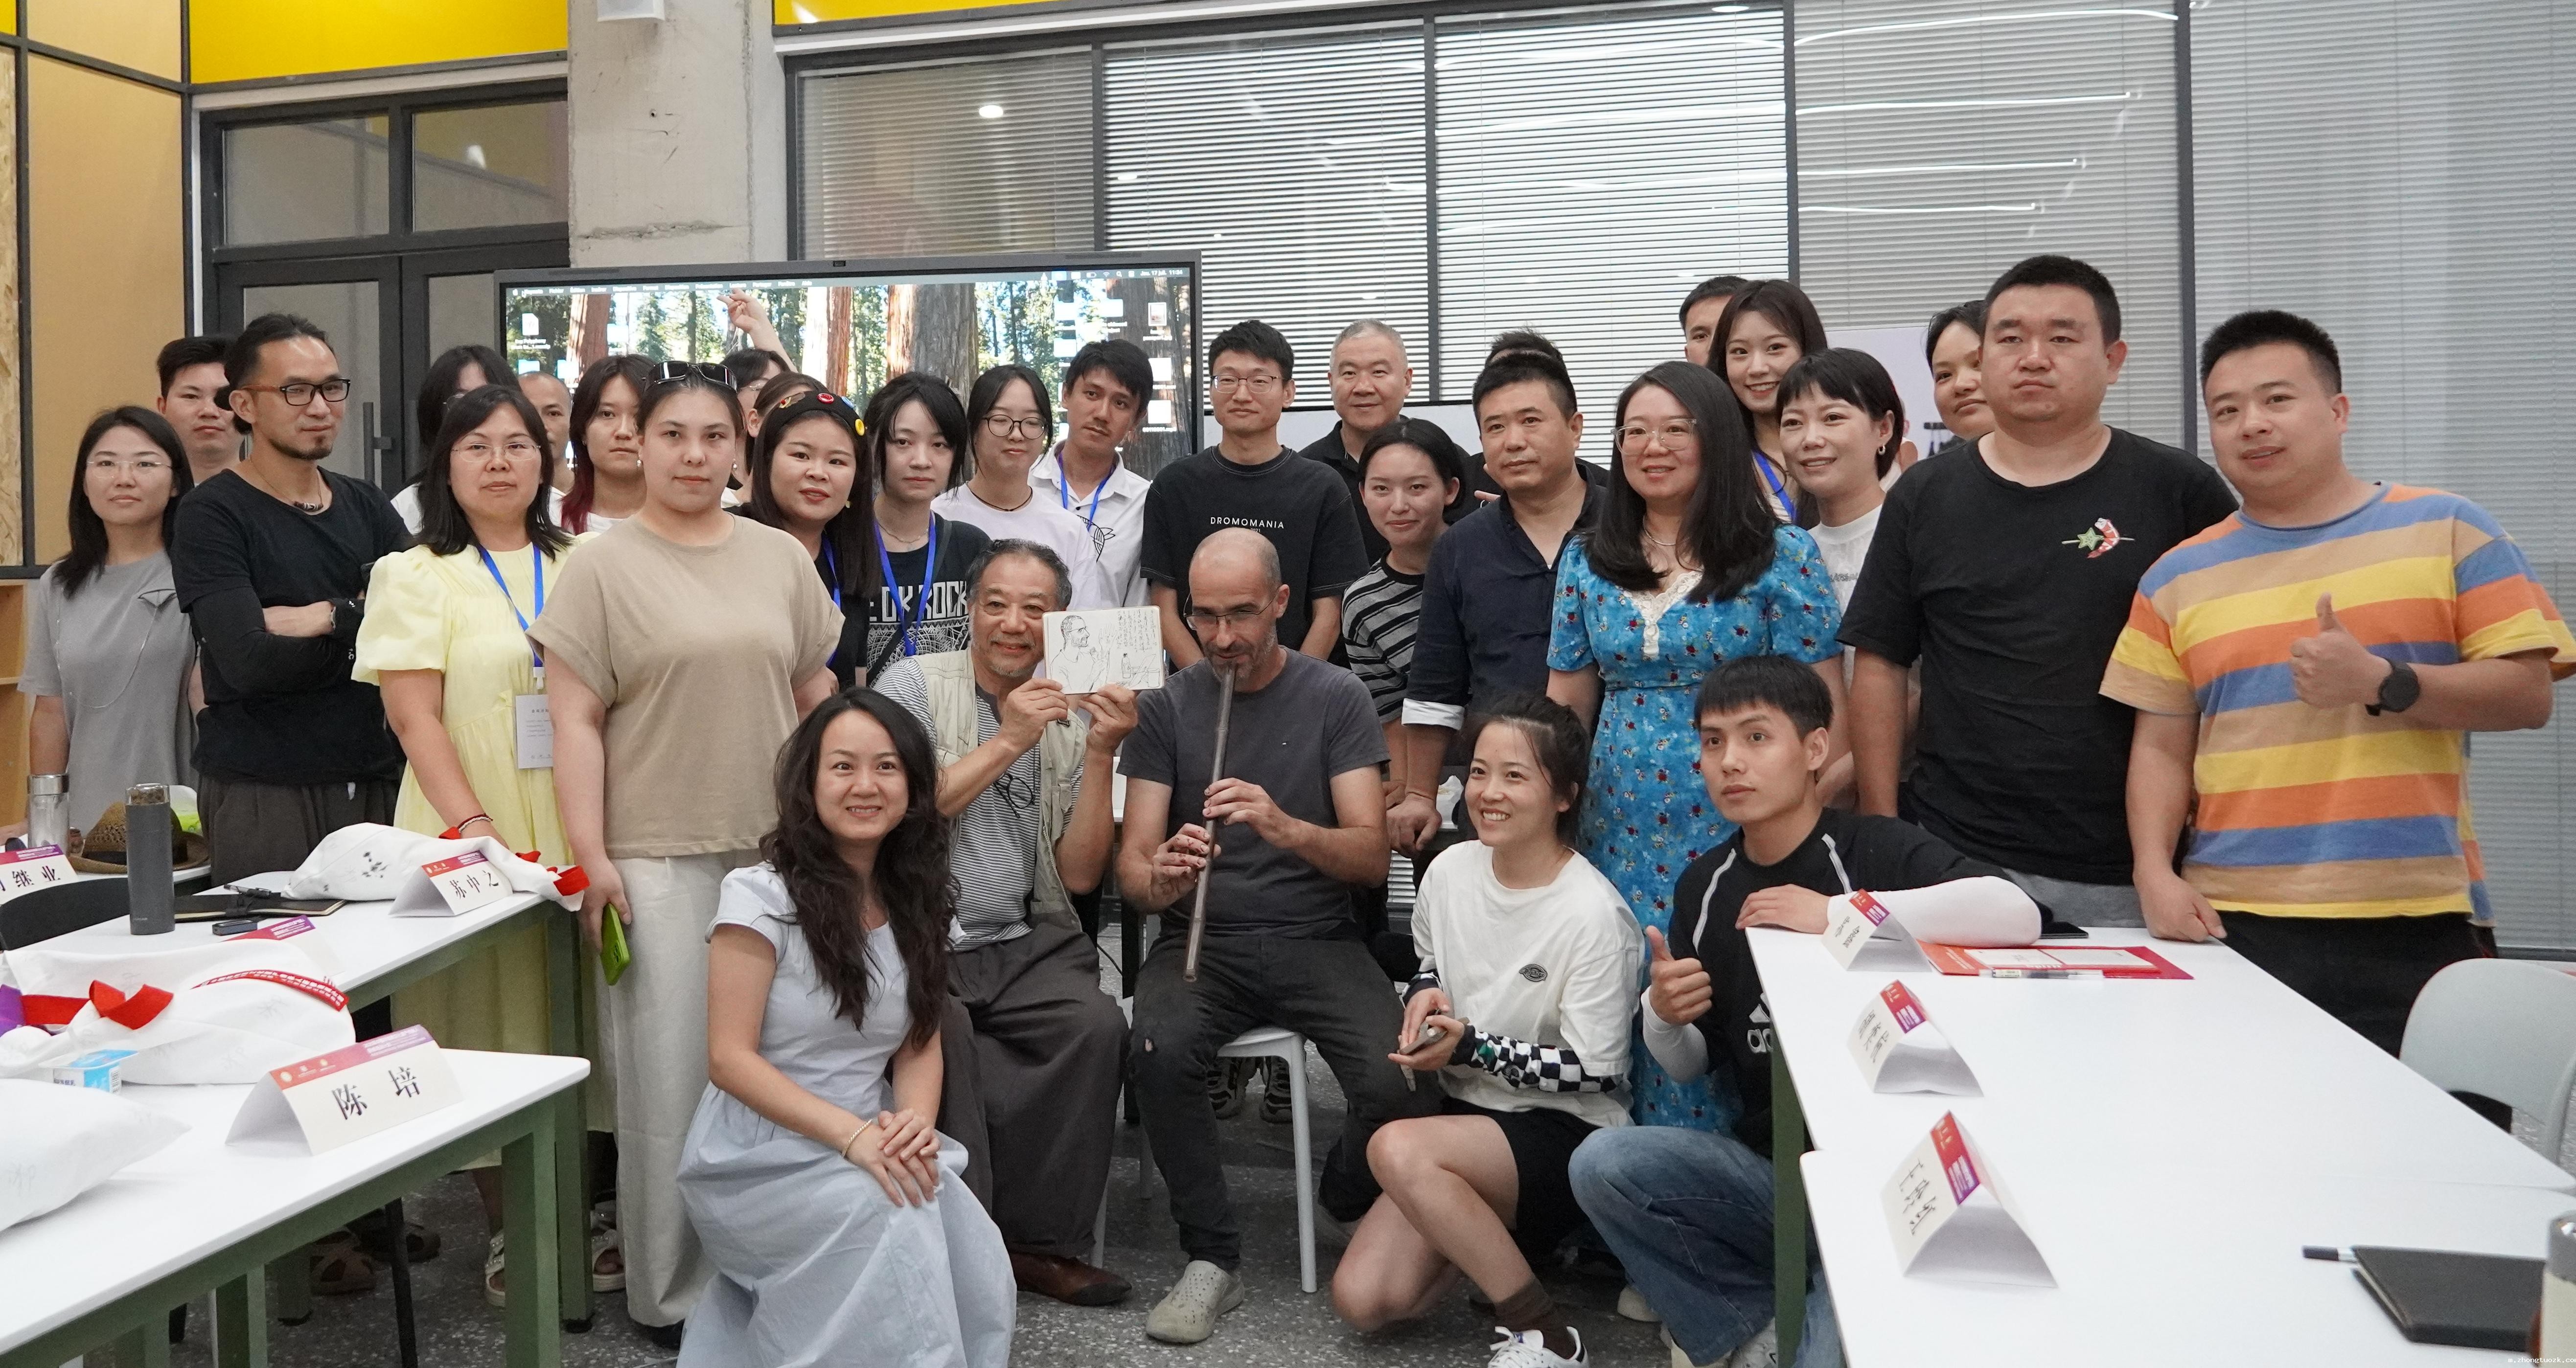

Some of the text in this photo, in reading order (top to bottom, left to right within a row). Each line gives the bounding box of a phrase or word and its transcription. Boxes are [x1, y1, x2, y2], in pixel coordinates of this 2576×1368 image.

[1210, 517, 1284, 529] DROMOMANIA
[449, 870, 499, 899] 苏中之
[331, 1066, 420, 1120] 陈培
